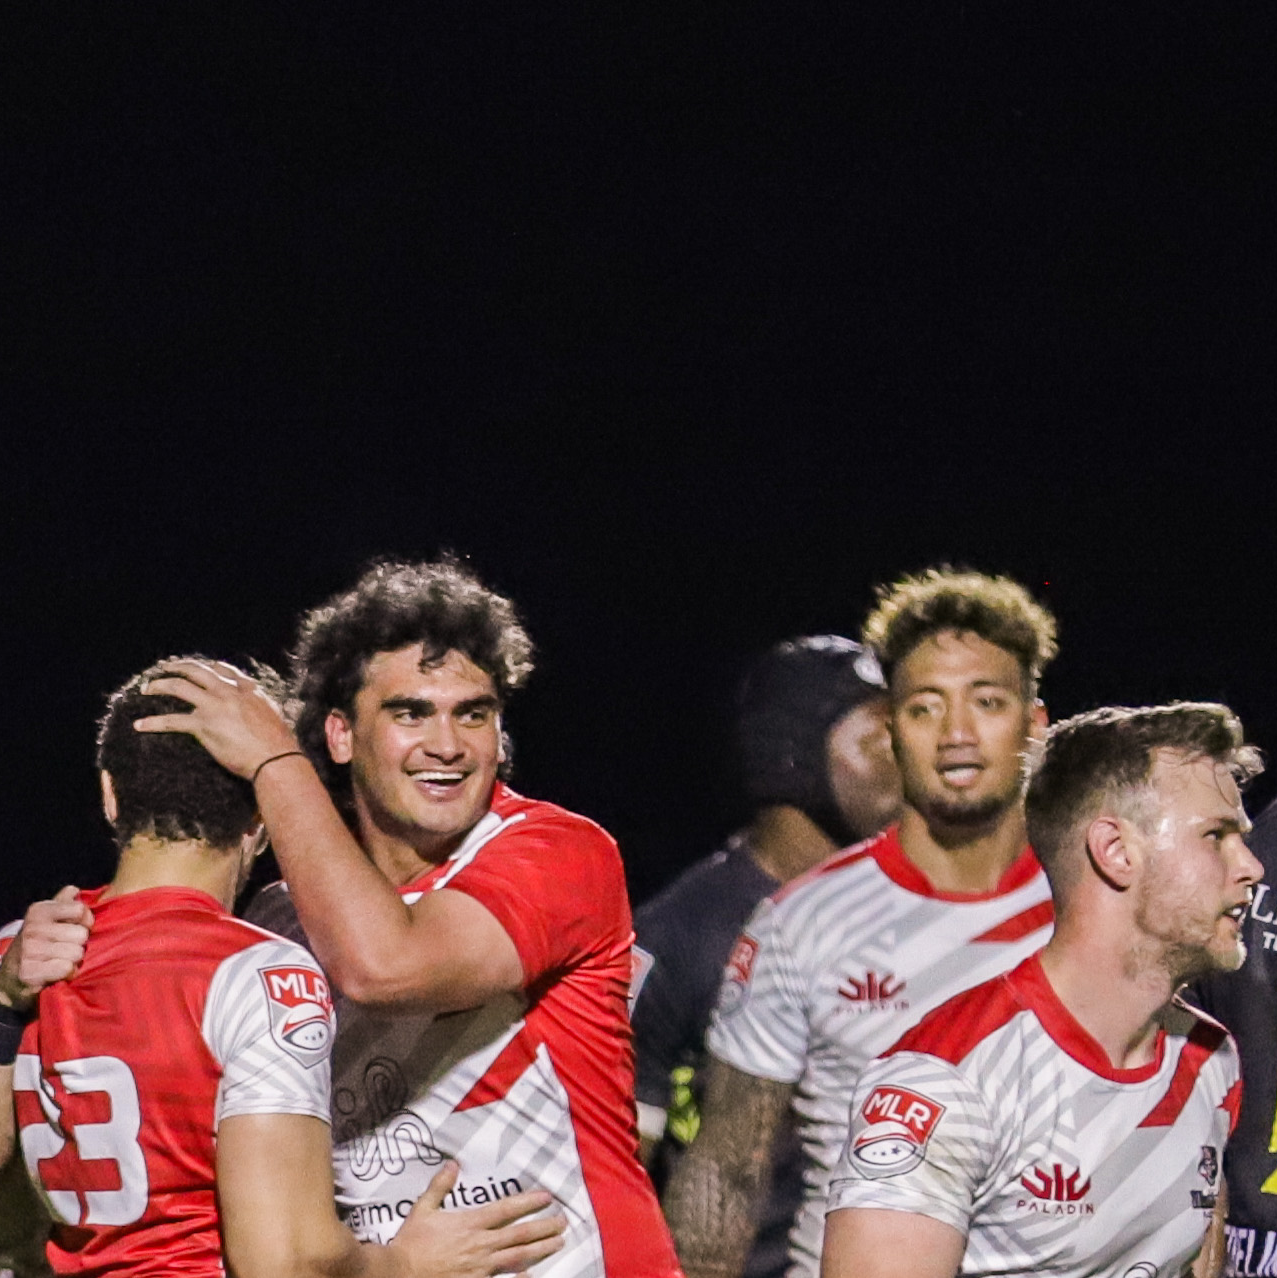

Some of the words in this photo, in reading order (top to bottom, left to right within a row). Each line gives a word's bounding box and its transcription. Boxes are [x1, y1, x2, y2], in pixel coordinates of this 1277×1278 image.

[270, 973, 329, 1009] MLR
[864, 1092, 931, 1131] MLR
[13, 1055, 149, 1226] 23
[1016, 1199, 1094, 1215] PALADIN
